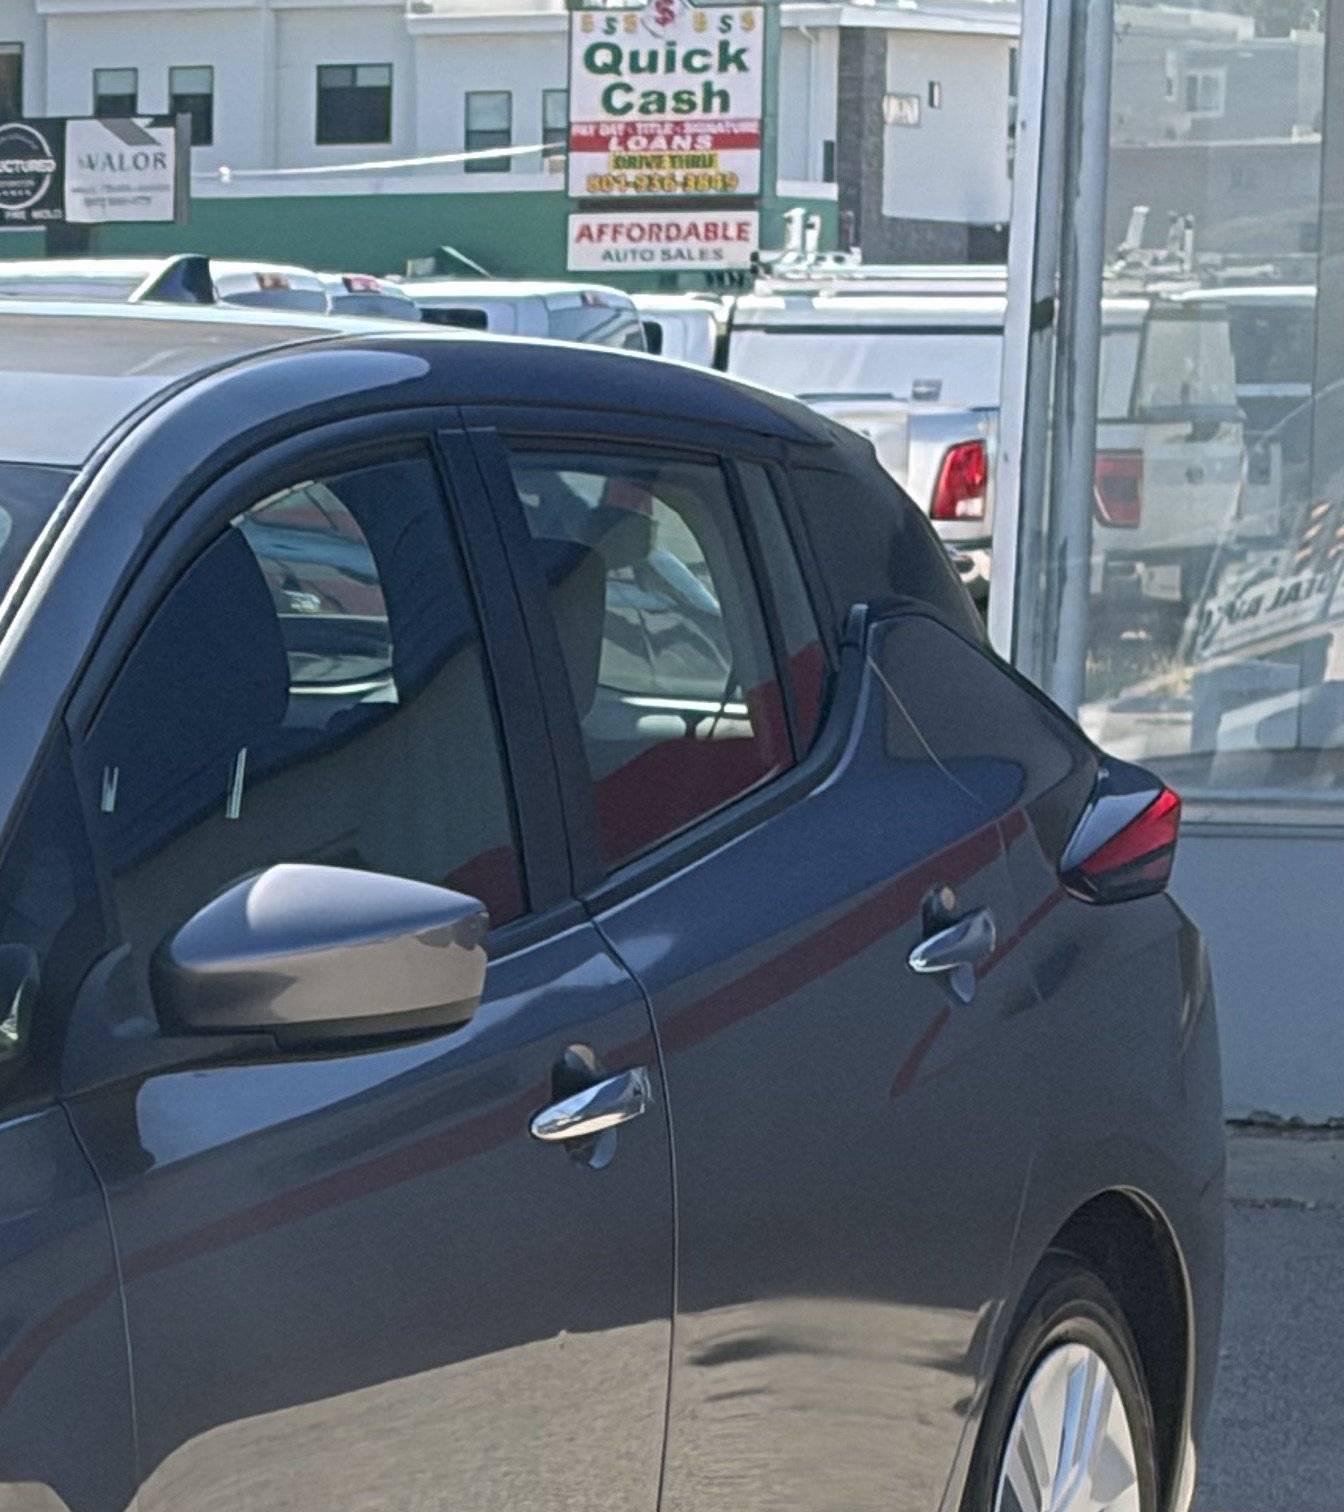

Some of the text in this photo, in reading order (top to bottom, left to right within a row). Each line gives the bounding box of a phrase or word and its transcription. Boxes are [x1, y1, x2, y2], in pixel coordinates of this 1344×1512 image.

[583, 40, 749, 76] Quick
[601, 81, 731, 116] Cash
[608, 135, 714, 151] LOANS
[574, 221, 751, 244] AFFORDABLE
[601, 247, 724, 263] AUTO SALES
